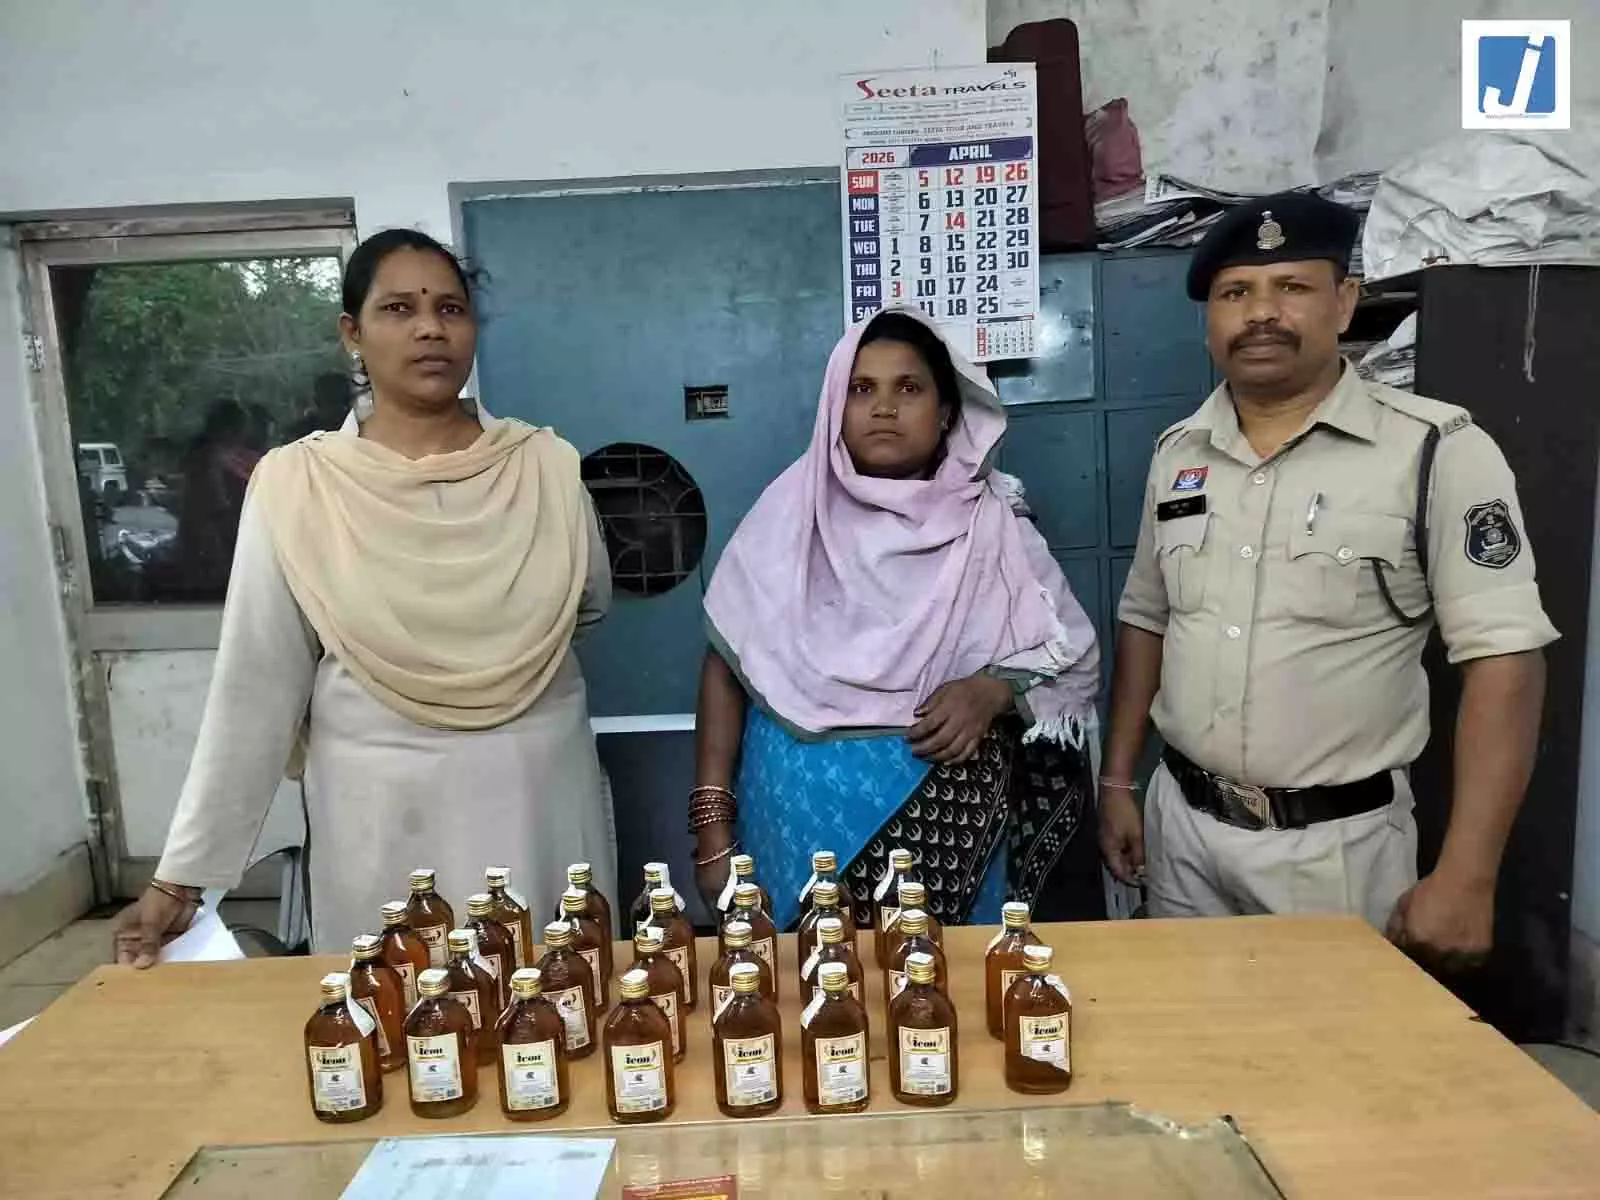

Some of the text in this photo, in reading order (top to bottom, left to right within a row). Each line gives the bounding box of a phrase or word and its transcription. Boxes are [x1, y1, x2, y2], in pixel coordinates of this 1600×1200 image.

[856, 77, 1027, 100] Seeta TRAVELS
[863, 144, 993, 165] 2026 APRIL
[852, 175, 875, 190] SUN
[919, 170, 928, 188] 5
[946, 168, 963, 186] 12
[976, 165, 995, 184] 19
[1006, 162, 1028, 181] 26
[853, 198, 875, 212] MON
[919, 192, 930, 210] 6
[946, 190, 964, 209] 13
[975, 188, 997, 206] 20
[1006, 185, 1028, 204] 27
[854, 220, 875, 233] TUE
[920, 214, 929, 232] 7
[945, 212, 965, 231] 14
[977, 210, 996, 228] 21
[1006, 207, 1029, 226] 28
[854, 229, 1029, 256] WED 1 8 15 22 29
[856, 251, 1029, 277] THU 2 9 16 23 30
[856, 285, 876, 298] FRI
[891, 281, 901, 299] 3
[917, 279, 936, 297] 10
[948, 277, 966, 295] 17
[976, 275, 998, 293] 24
[947, 299, 967, 317] 18
[977, 296, 998, 315] 25
